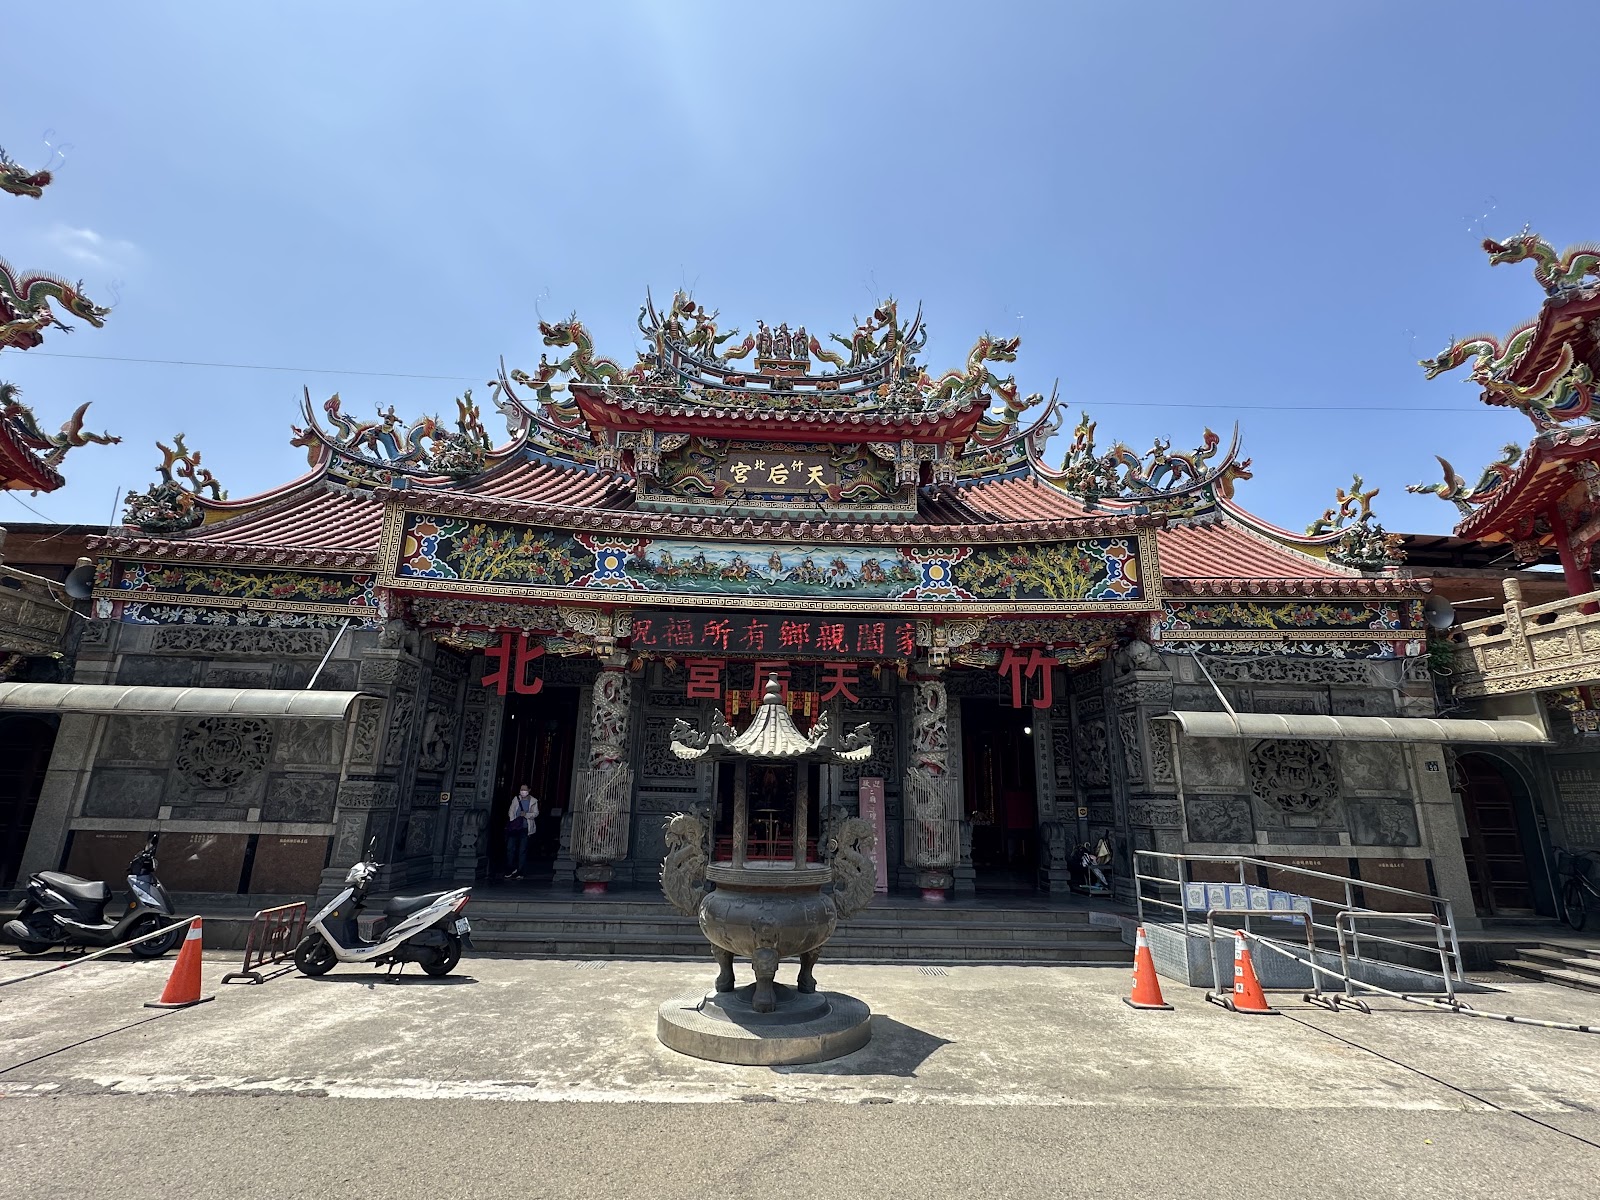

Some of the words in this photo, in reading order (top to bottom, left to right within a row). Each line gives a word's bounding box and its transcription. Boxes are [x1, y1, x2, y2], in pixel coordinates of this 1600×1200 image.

[754, 459, 804, 473] 竹北
[481, 633, 545, 696] 北
[998, 648, 1059, 709] 竹
